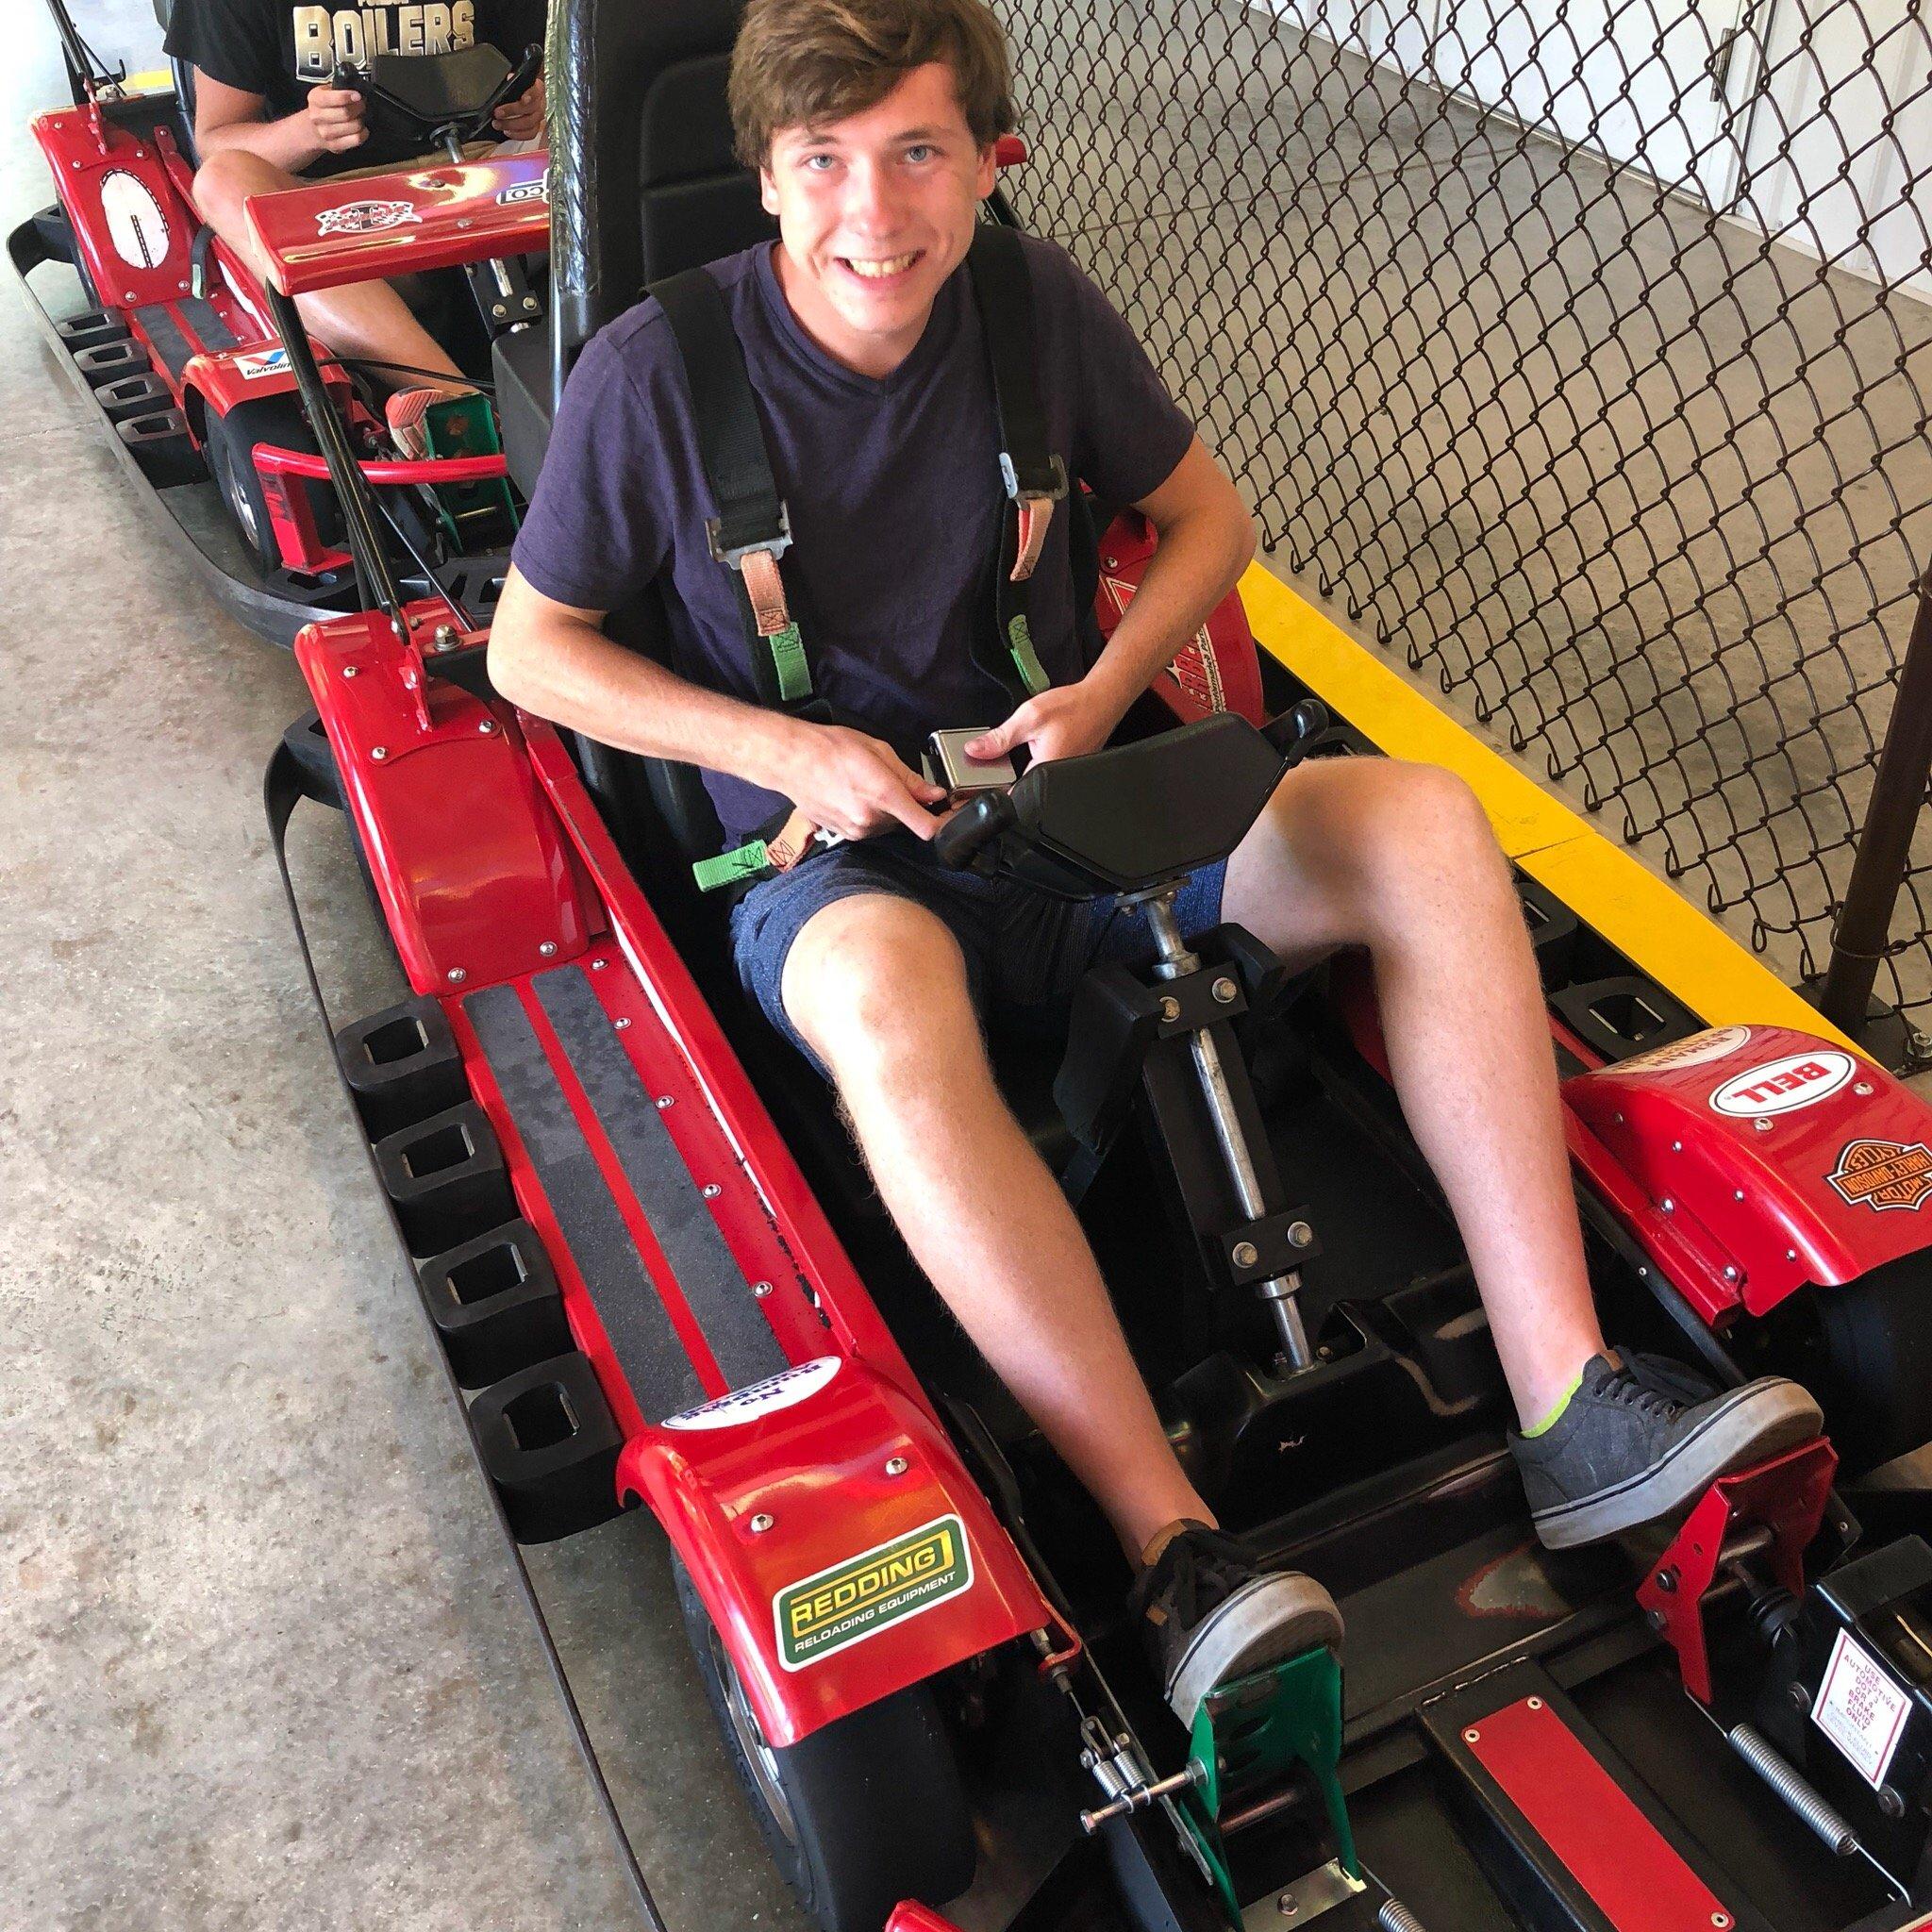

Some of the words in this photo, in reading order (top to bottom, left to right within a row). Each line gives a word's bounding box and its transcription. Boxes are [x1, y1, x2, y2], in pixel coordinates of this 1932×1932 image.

[292, 0, 475, 83] BOILERS
[246, 362, 291, 375] Valvolin
[1732, 1061, 1833, 1104] BELL
[1850, 1147, 1896, 1169] CYCLES
[1842, 1153, 1932, 1193] HARLEY-DAVIDSON
[1877, 1177, 1924, 1200] MOTOR
[741, 1388, 785, 1406] No
[791, 1546, 937, 1628] REDDING
[794, 1609, 875, 1653] RELOADING
[878, 1571, 956, 1614] EQUIPMENT
[1844, 1655, 1896, 1712] AUTOMOTIVE
[1856, 1675, 1872, 1695] DOT
[1865, 1664, 1880, 1685] USE
[1849, 1690, 1875, 1721] BRAKE
[1855, 1686, 1867, 1702] OR
[1846, 1707, 1867, 1731] ONLY
[1847, 1699, 1871, 1726] FLUID
